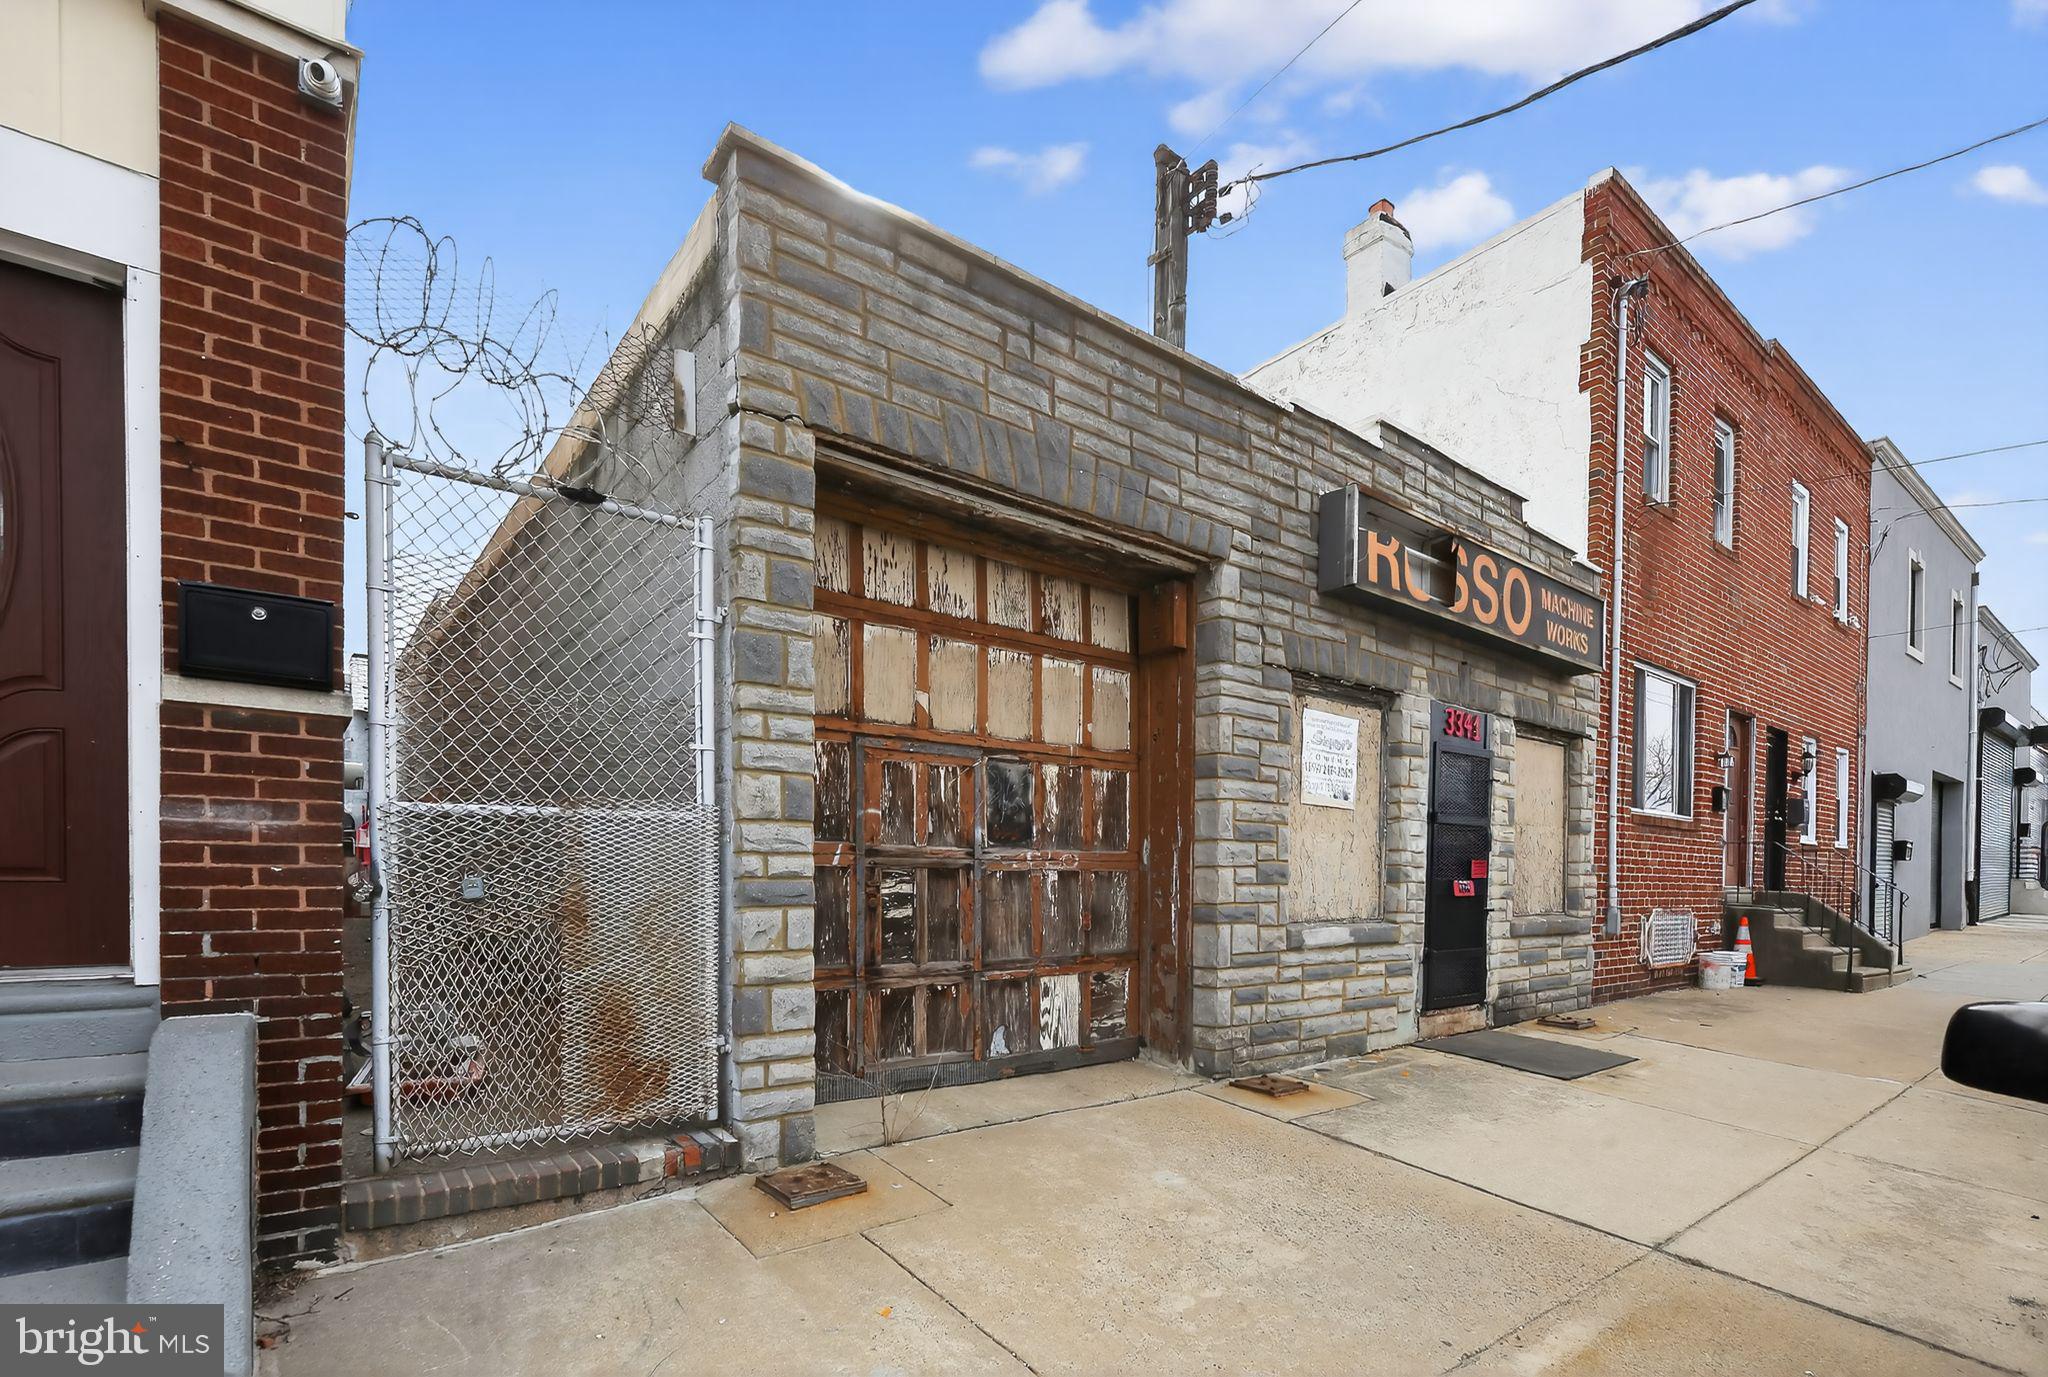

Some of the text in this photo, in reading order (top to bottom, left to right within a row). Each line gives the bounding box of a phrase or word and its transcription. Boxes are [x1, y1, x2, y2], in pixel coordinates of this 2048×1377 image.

[1541, 587, 1594, 629] MACHINE
[1546, 619, 1589, 655] WORKS
[1444, 707, 1482, 742] 3341
